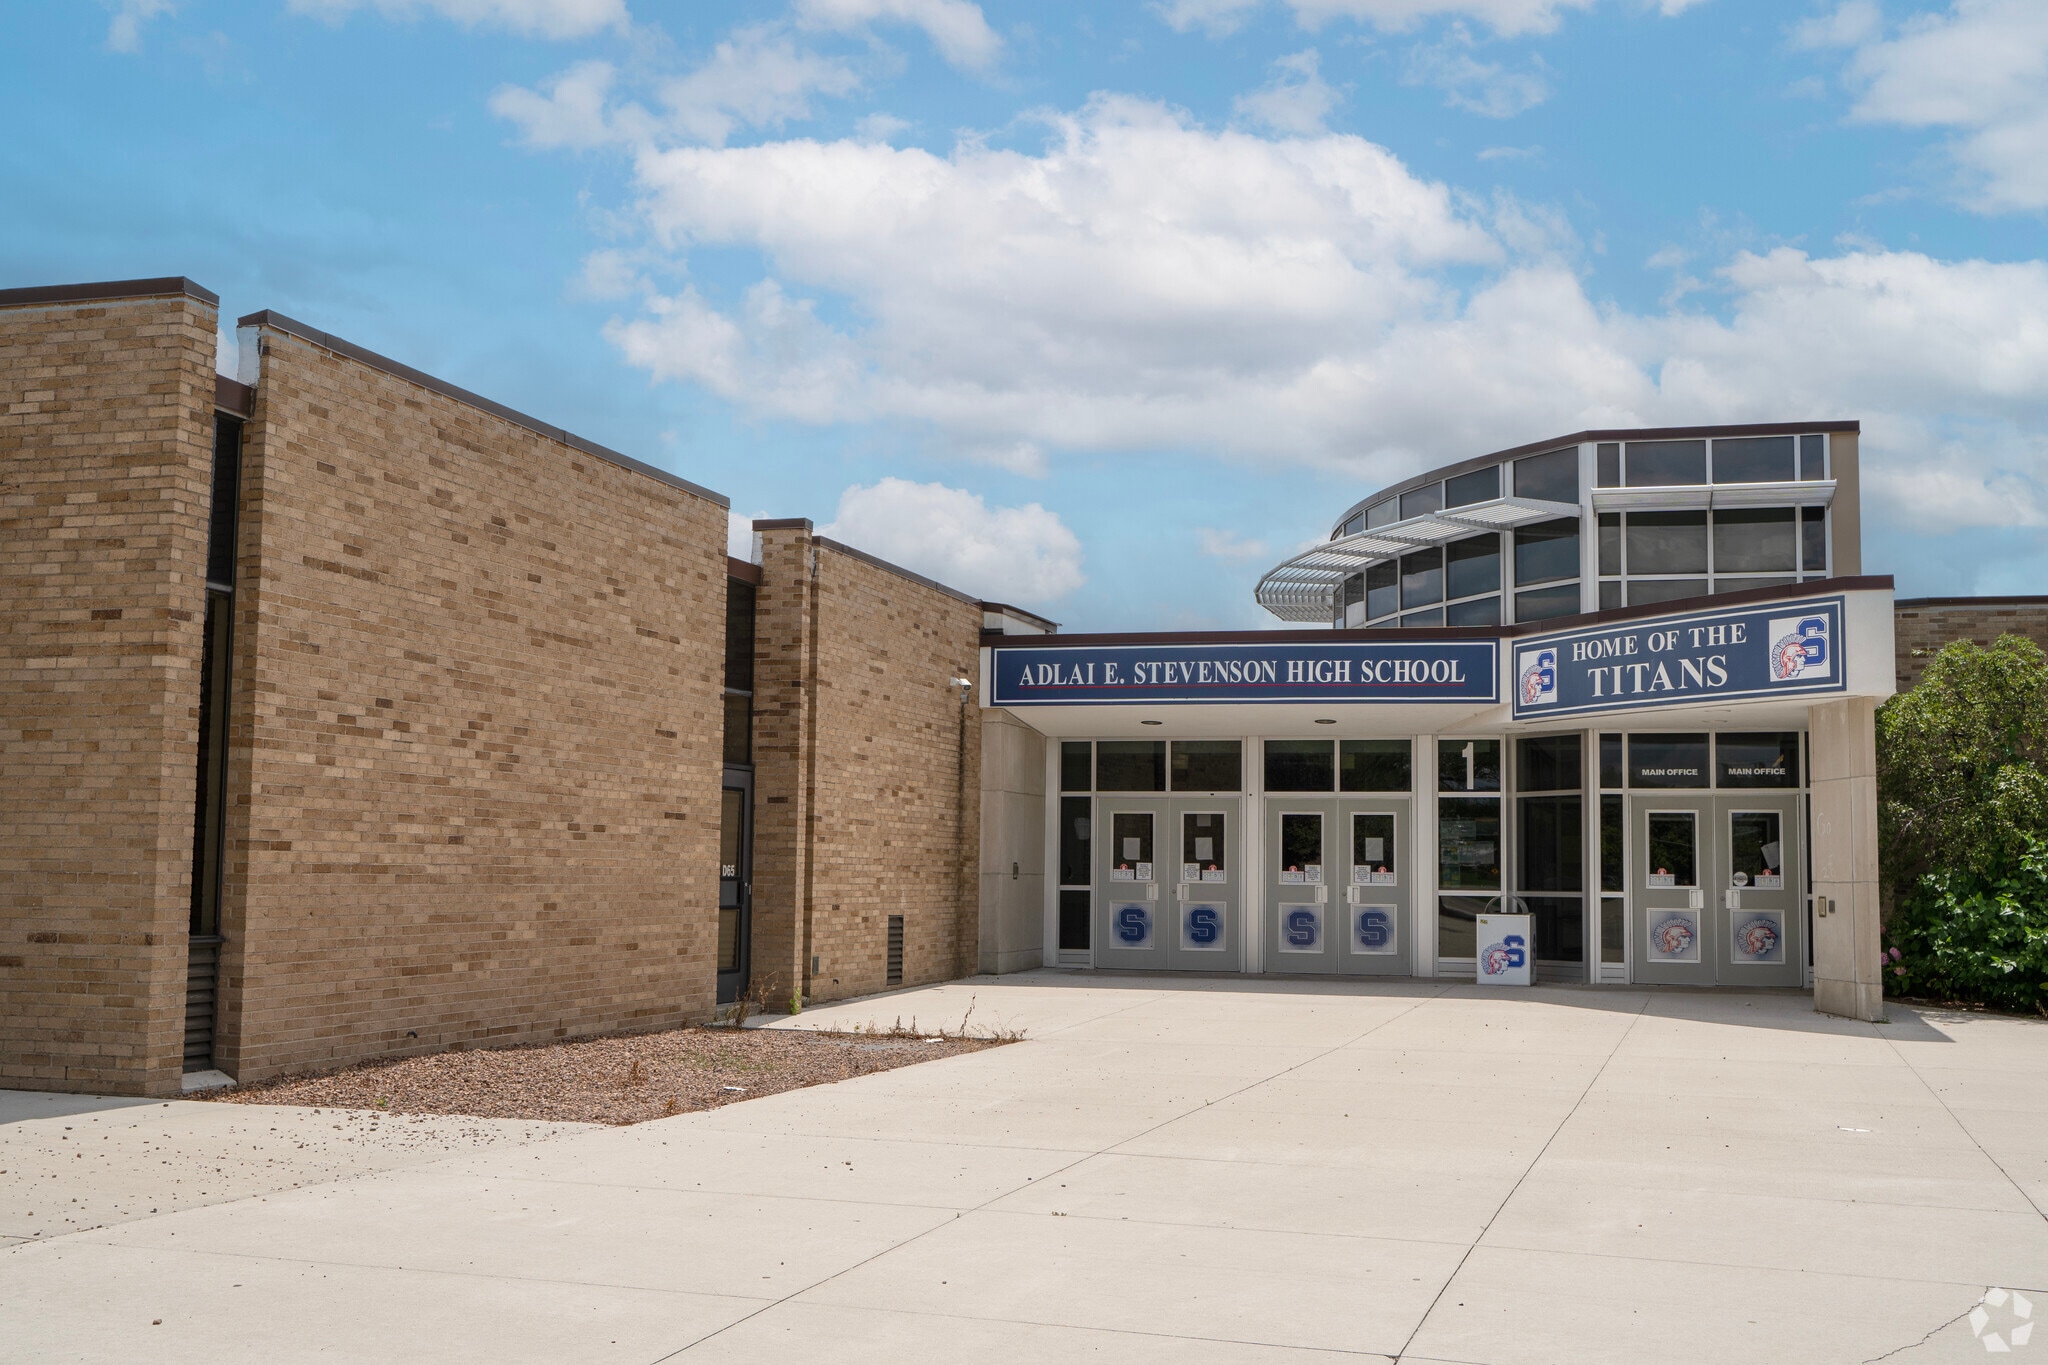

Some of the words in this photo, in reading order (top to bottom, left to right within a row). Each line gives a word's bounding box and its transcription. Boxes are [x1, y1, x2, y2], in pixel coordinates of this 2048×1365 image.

[1571, 635, 1639, 662] HOME
[1647, 630, 1681, 653] OF
[1687, 622, 1748, 649] THE
[1018, 662, 1095, 686] ADLAI
[1103, 661, 1125, 685] E.
[1134, 660, 1278, 685] STEVENSON
[1286, 659, 1352, 683] HIGH
[1361, 658, 1466, 683] SCHOOL
[1587, 654, 1728, 698] TITANS
[1461, 741, 1475, 790] 1
[1641, 768, 1666, 776] MAIN
[1666, 768, 1699, 776] OFFICE
[1119, 907, 1147, 942] S
[1189, 908, 1218, 943] S
[1287, 911, 1316, 946] S
[1359, 911, 1389, 946] S
